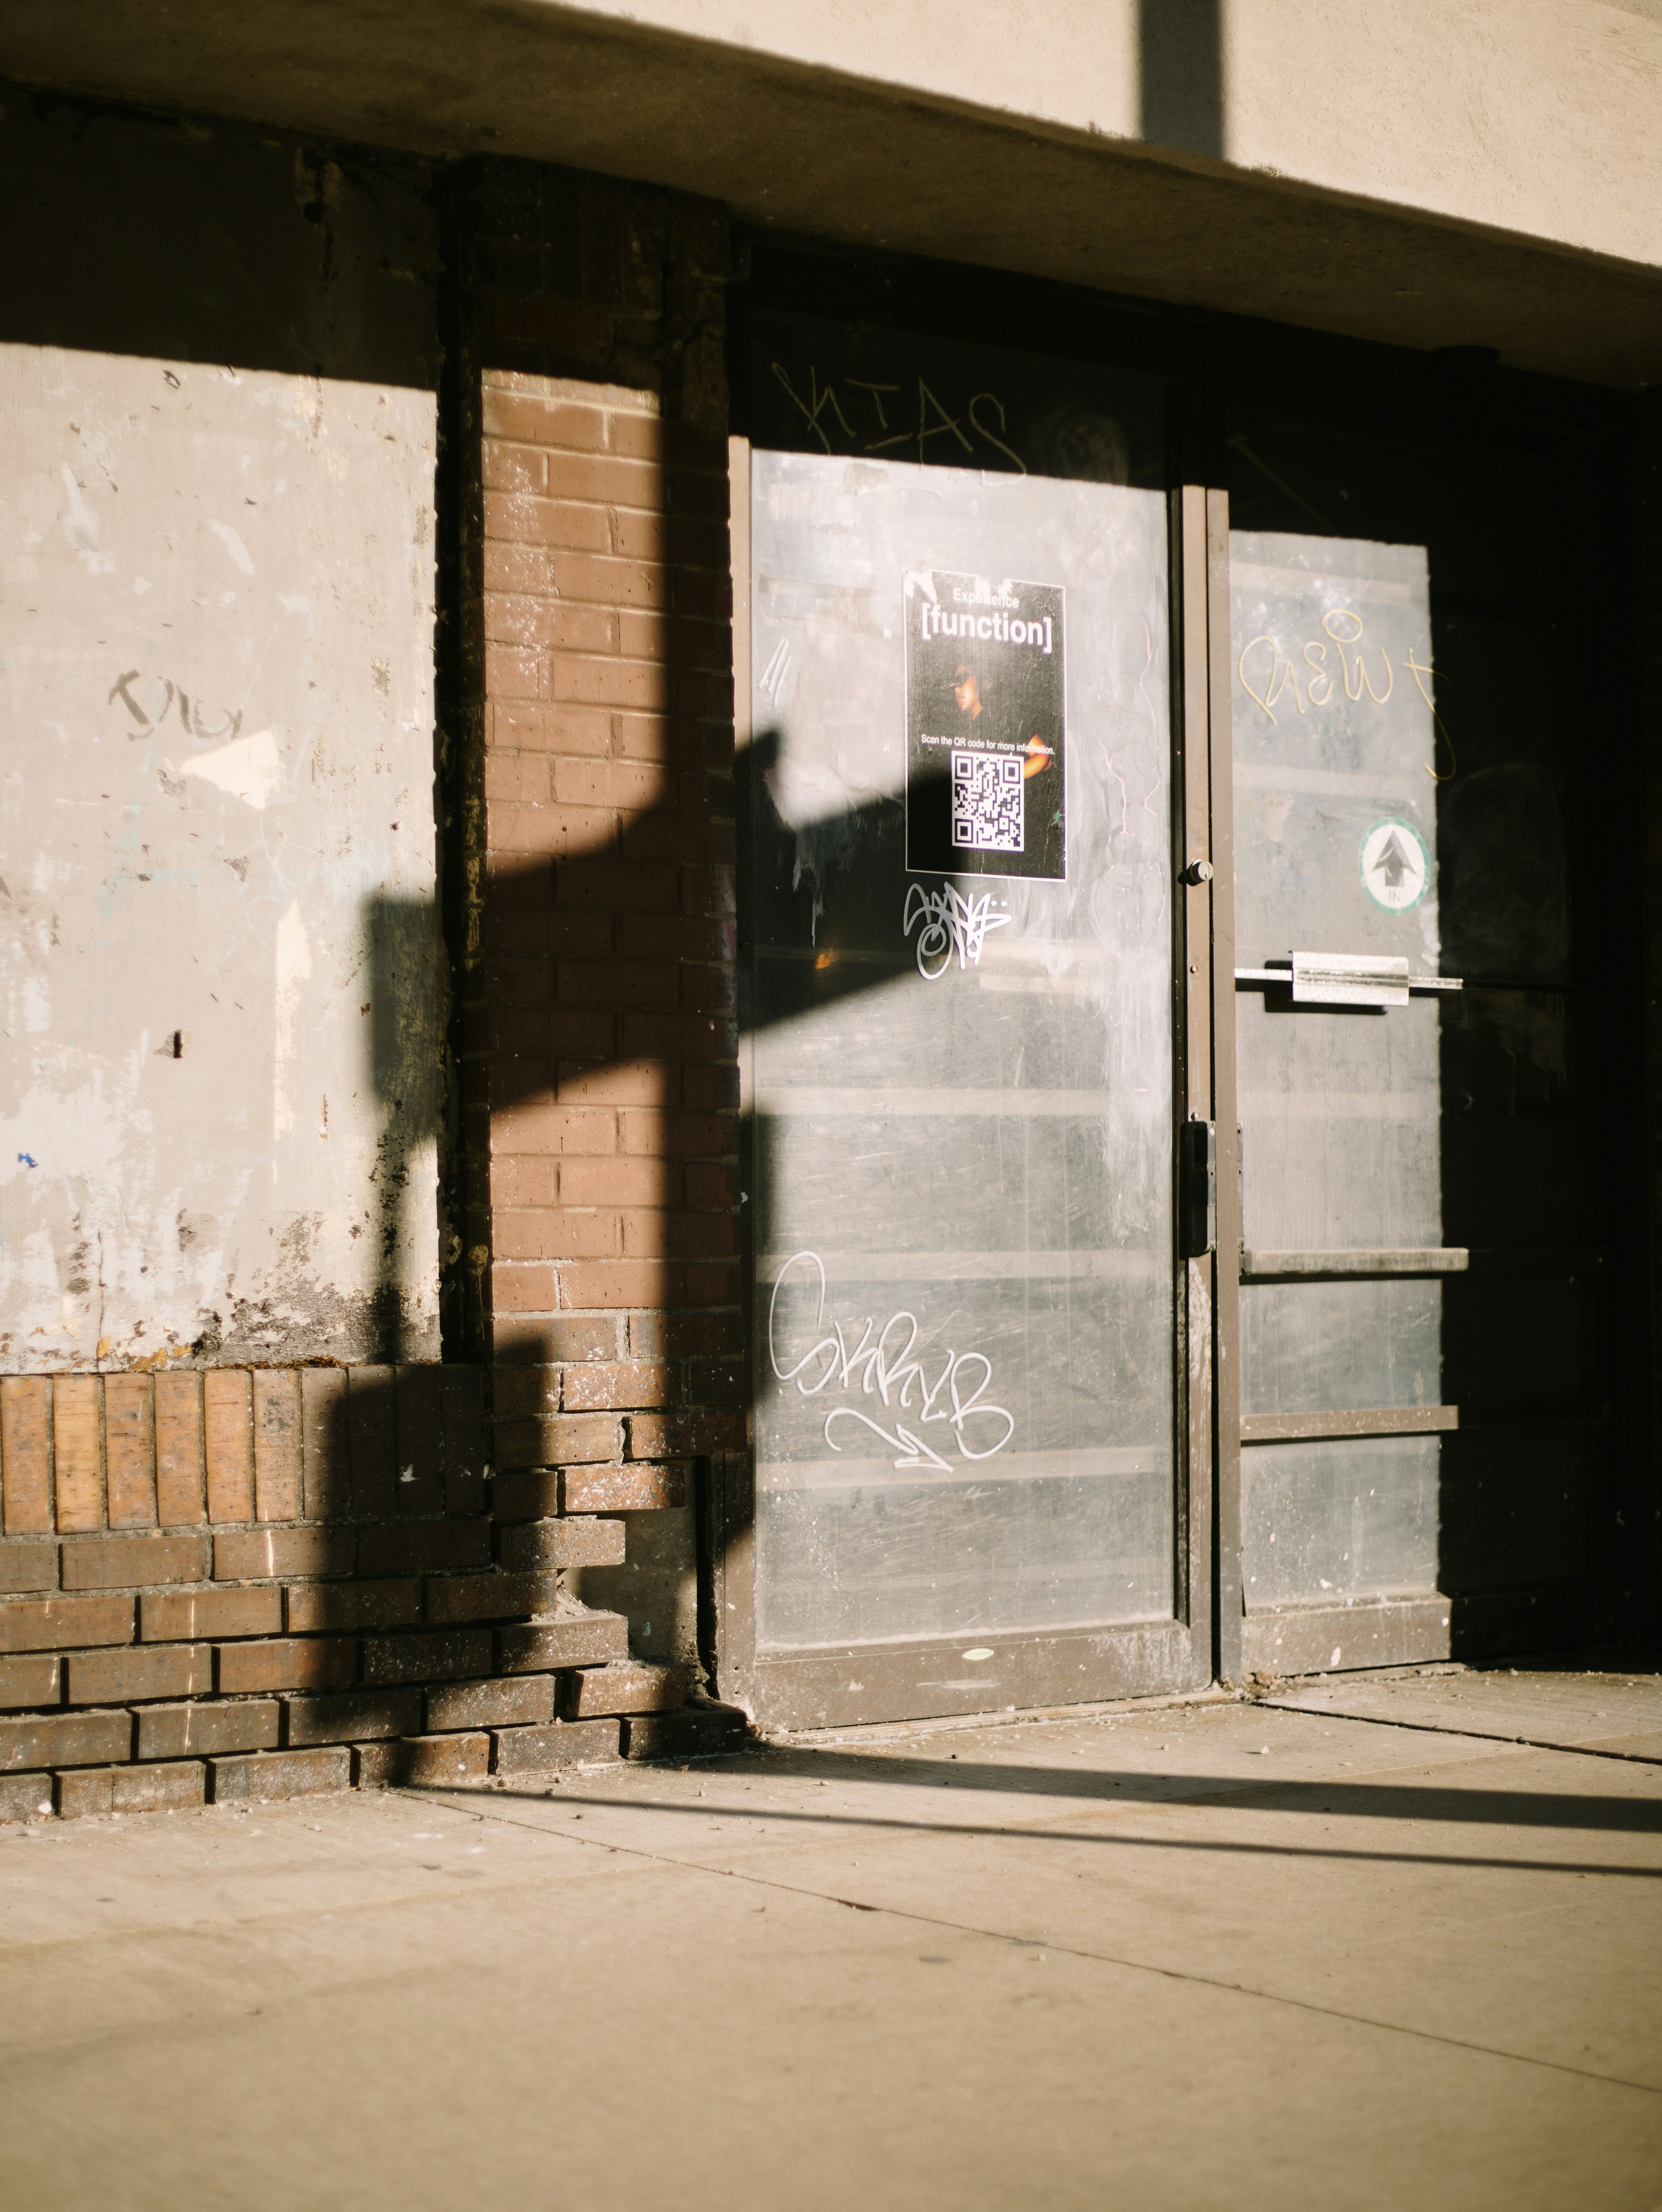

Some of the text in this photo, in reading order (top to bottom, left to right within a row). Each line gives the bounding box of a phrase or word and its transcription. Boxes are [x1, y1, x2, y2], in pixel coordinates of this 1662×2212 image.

[953, 588, 1019, 608] Expeence
[922, 603, 1052, 653] [function]
[921, 734, 1055, 755] Scan the QR code for more information.
[1388, 889, 1401, 902] IN
